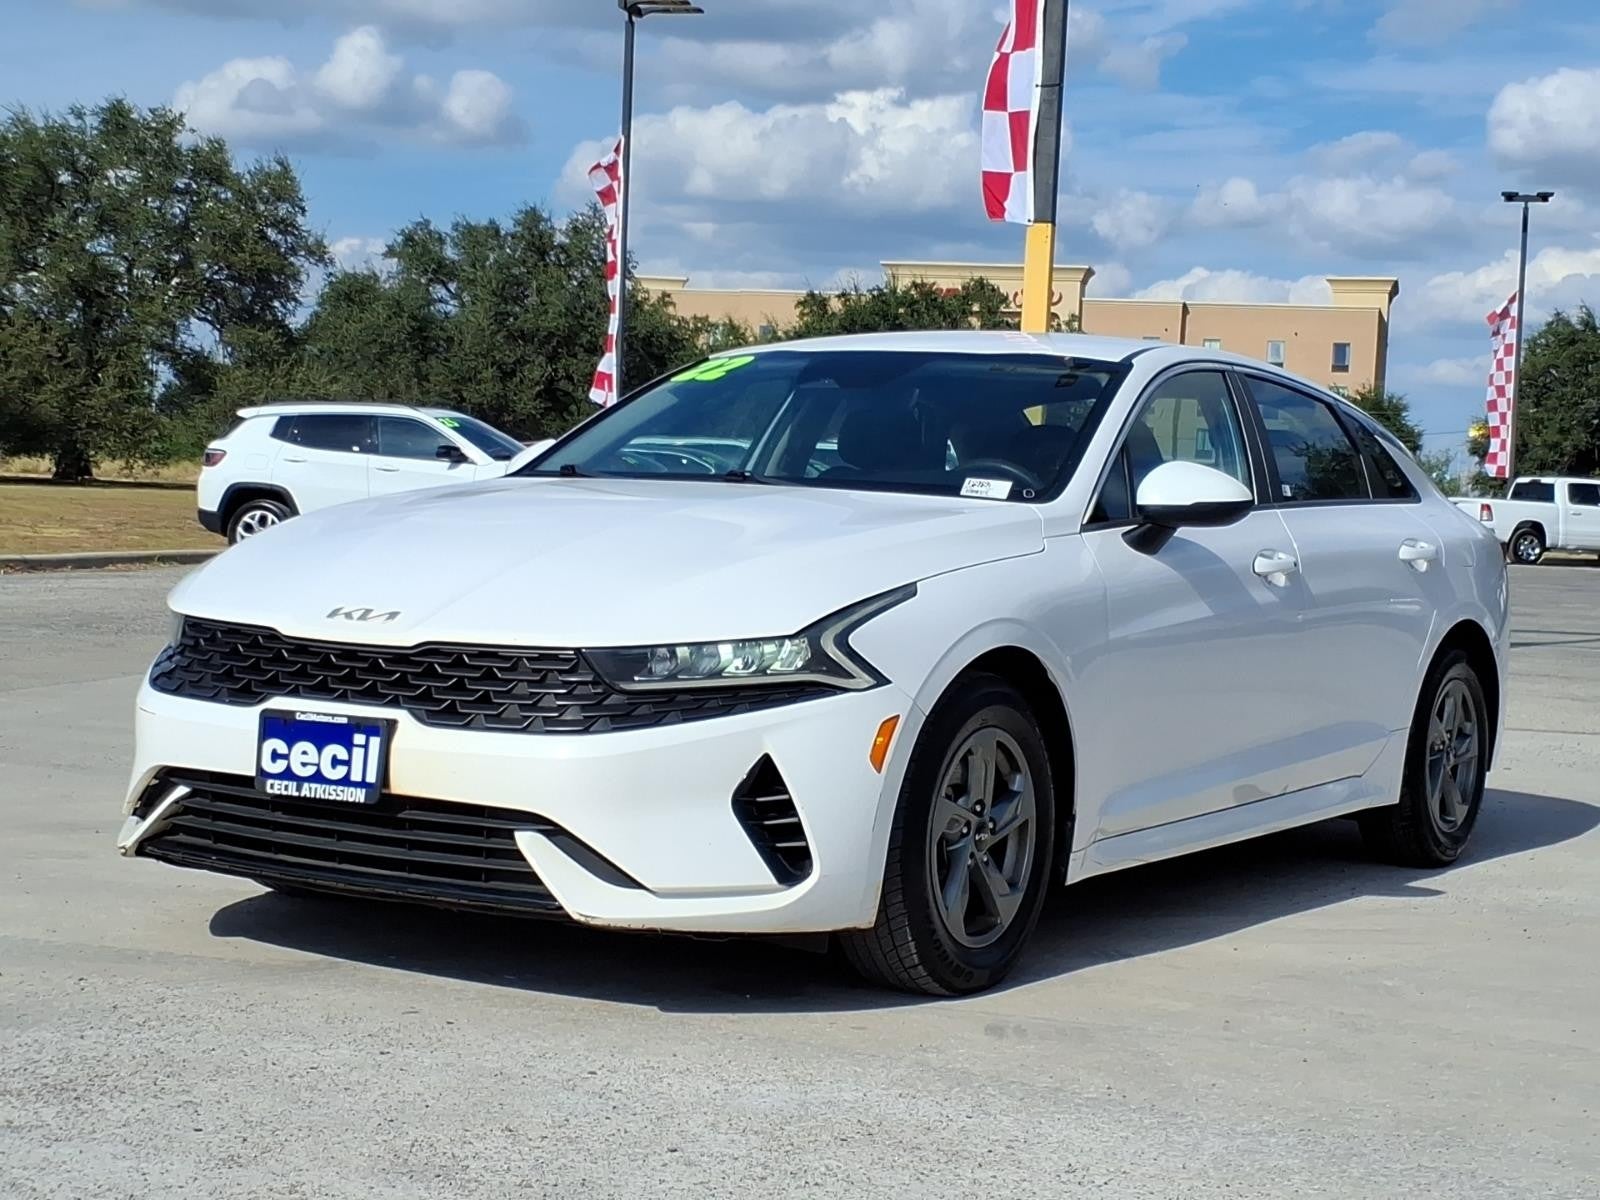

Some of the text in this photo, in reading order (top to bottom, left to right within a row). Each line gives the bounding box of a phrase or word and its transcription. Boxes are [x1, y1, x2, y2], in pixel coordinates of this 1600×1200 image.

[326, 606, 402, 622] KIA
[261, 733, 381, 783] cecil
[266, 779, 366, 804] CECIL ATKISSION
